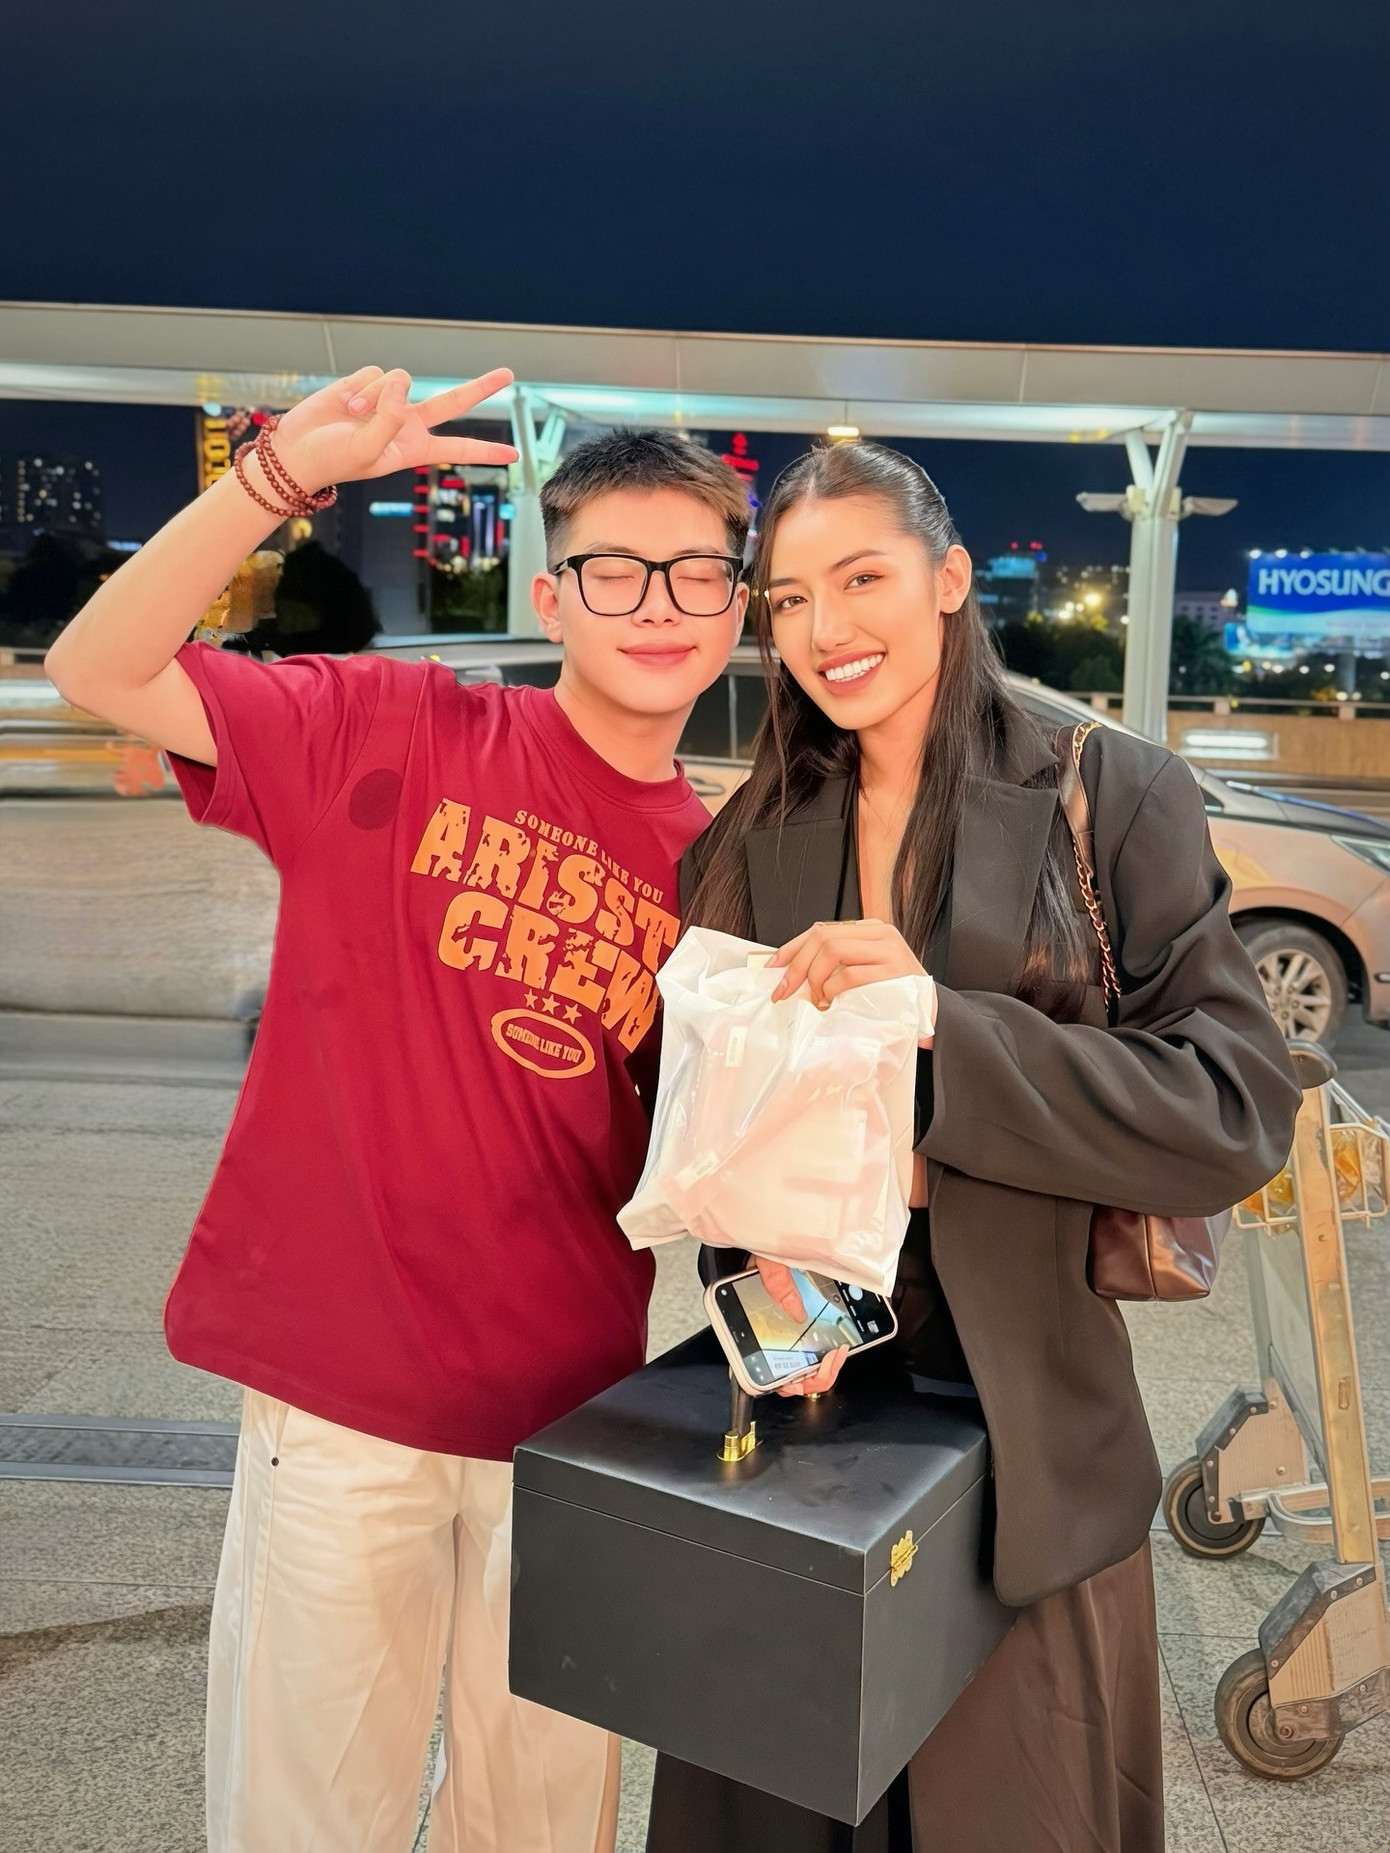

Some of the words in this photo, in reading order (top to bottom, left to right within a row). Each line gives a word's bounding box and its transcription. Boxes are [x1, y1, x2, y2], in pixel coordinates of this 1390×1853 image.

[1258, 568, 1390, 596] HYOSUNG
[513, 809, 599, 856] SOMEONE
[601, 849, 630, 885] LIKE
[633, 876, 664, 904] YOU
[438, 891, 660, 1053] CREW
[540, 1038, 563, 1058] LIKE
[562, 1045, 582, 1064] YOU
